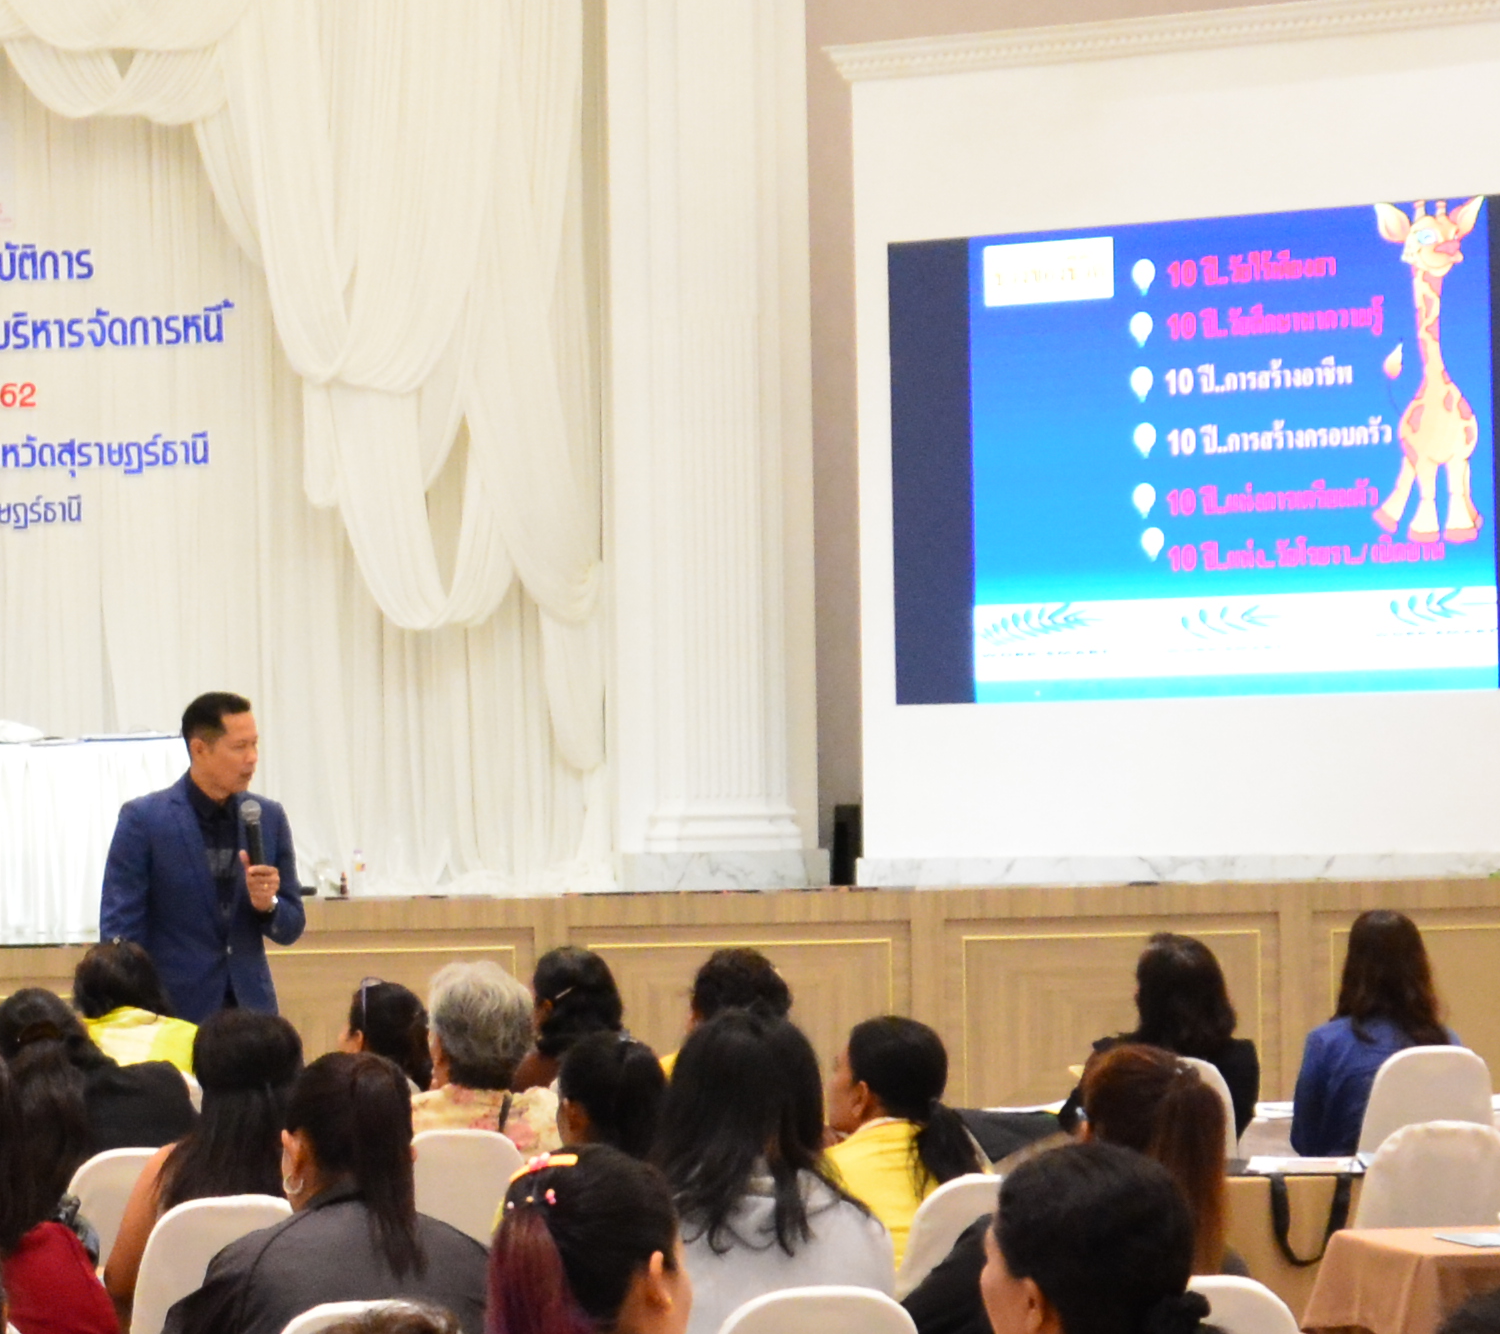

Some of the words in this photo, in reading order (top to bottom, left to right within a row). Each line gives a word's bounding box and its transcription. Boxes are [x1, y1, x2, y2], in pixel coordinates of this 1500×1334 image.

[1167, 259, 1197, 287] 10
[1167, 311, 1197, 340] 10
[1165, 367, 1194, 395] 10
[1167, 427, 1196, 456] 10
[1167, 488, 1197, 516] 10
[1168, 544, 1197, 572] 10
